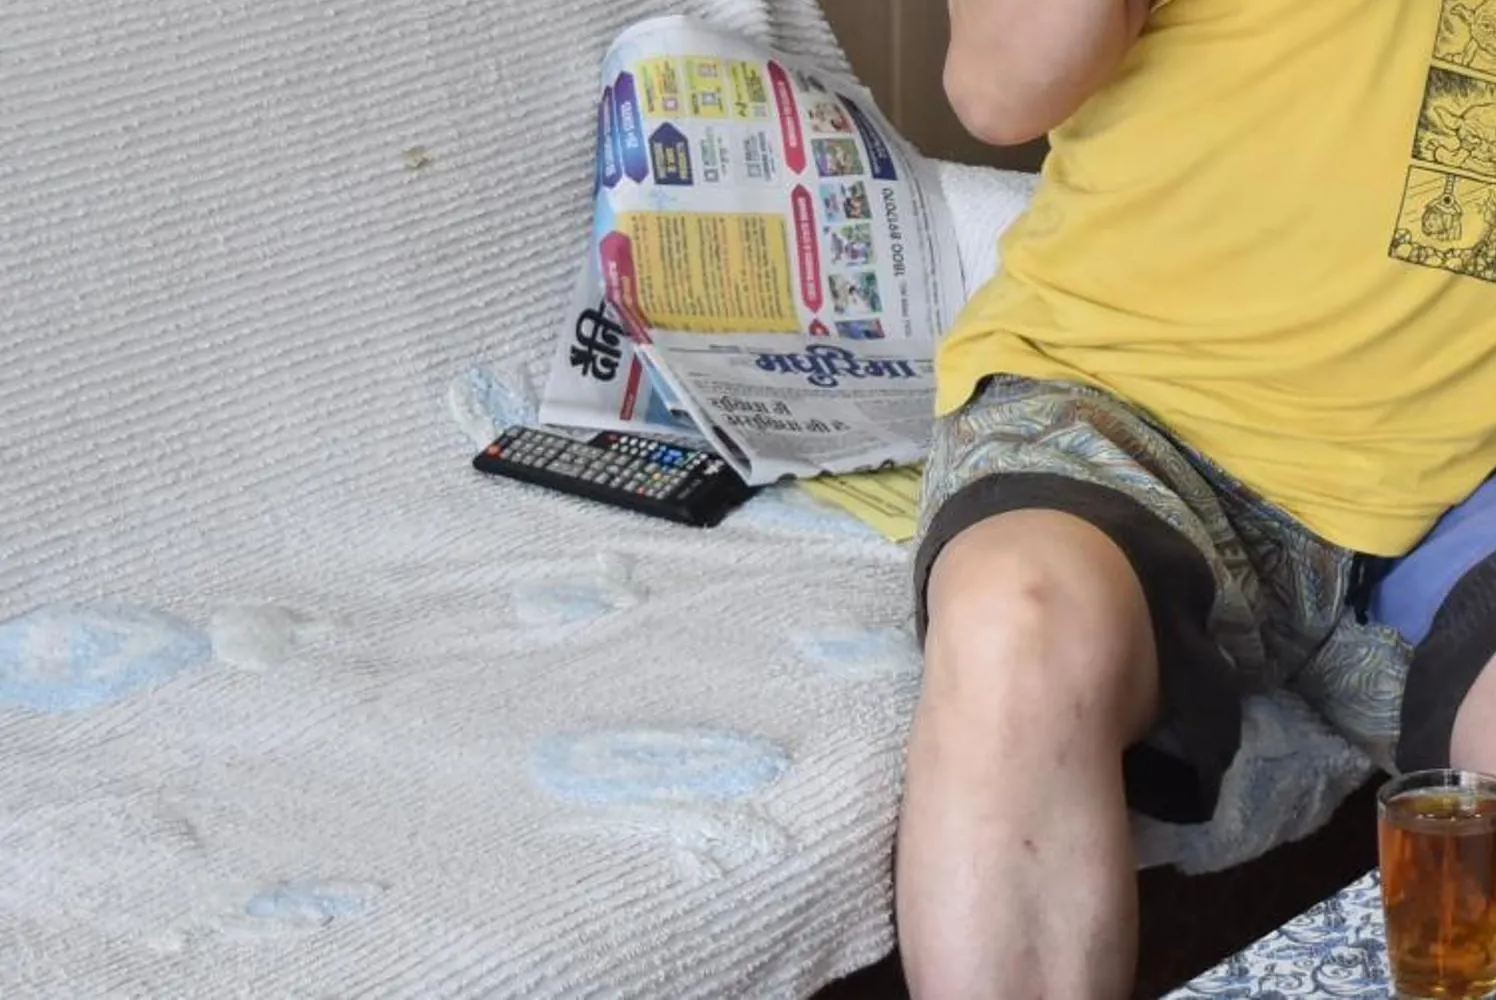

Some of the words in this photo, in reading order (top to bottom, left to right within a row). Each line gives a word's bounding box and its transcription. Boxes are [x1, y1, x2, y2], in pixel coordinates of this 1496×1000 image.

[890, 242, 906, 278] 1800
[569, 299, 626, 382] दैनि
[755, 343, 918, 389] मधुरिमा
